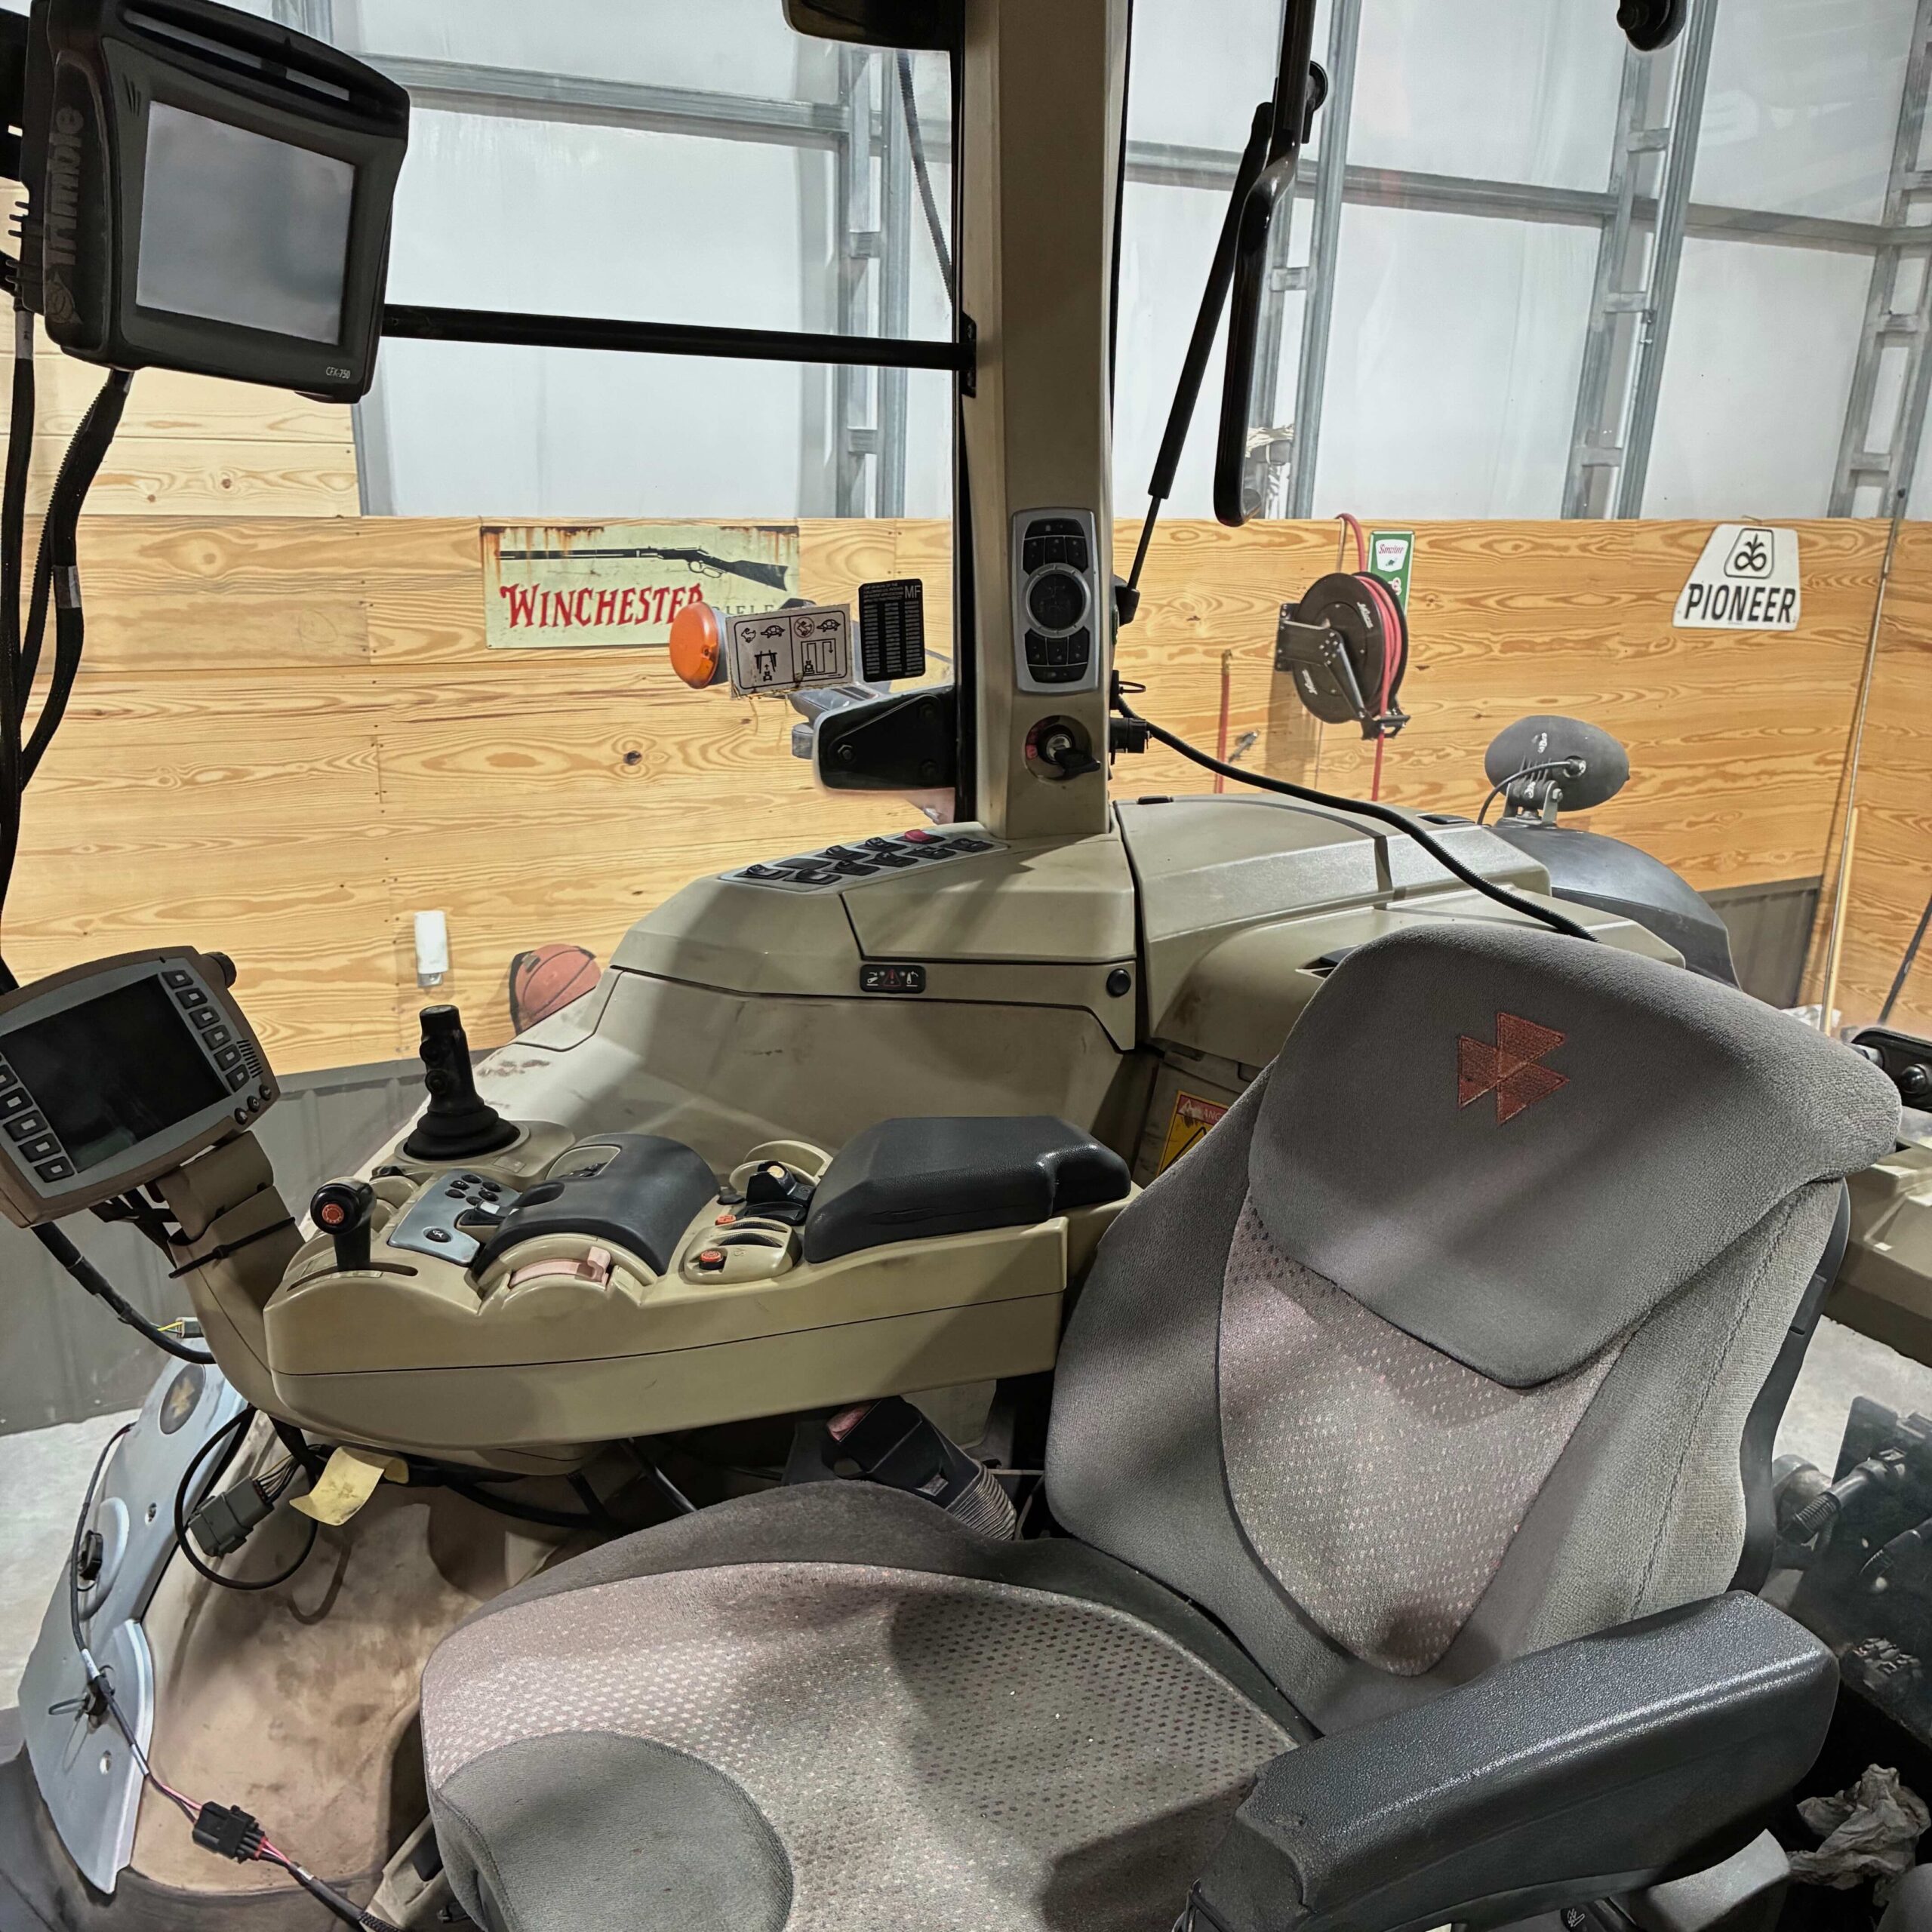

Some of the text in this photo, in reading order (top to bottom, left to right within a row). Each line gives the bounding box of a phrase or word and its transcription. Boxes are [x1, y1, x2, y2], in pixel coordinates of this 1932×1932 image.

[45, 106, 84, 264] Trimble
[325, 366, 351, 379] CFX-750
[904, 584, 921, 599] MF
[1684, 583, 1796, 623] PIONEER
